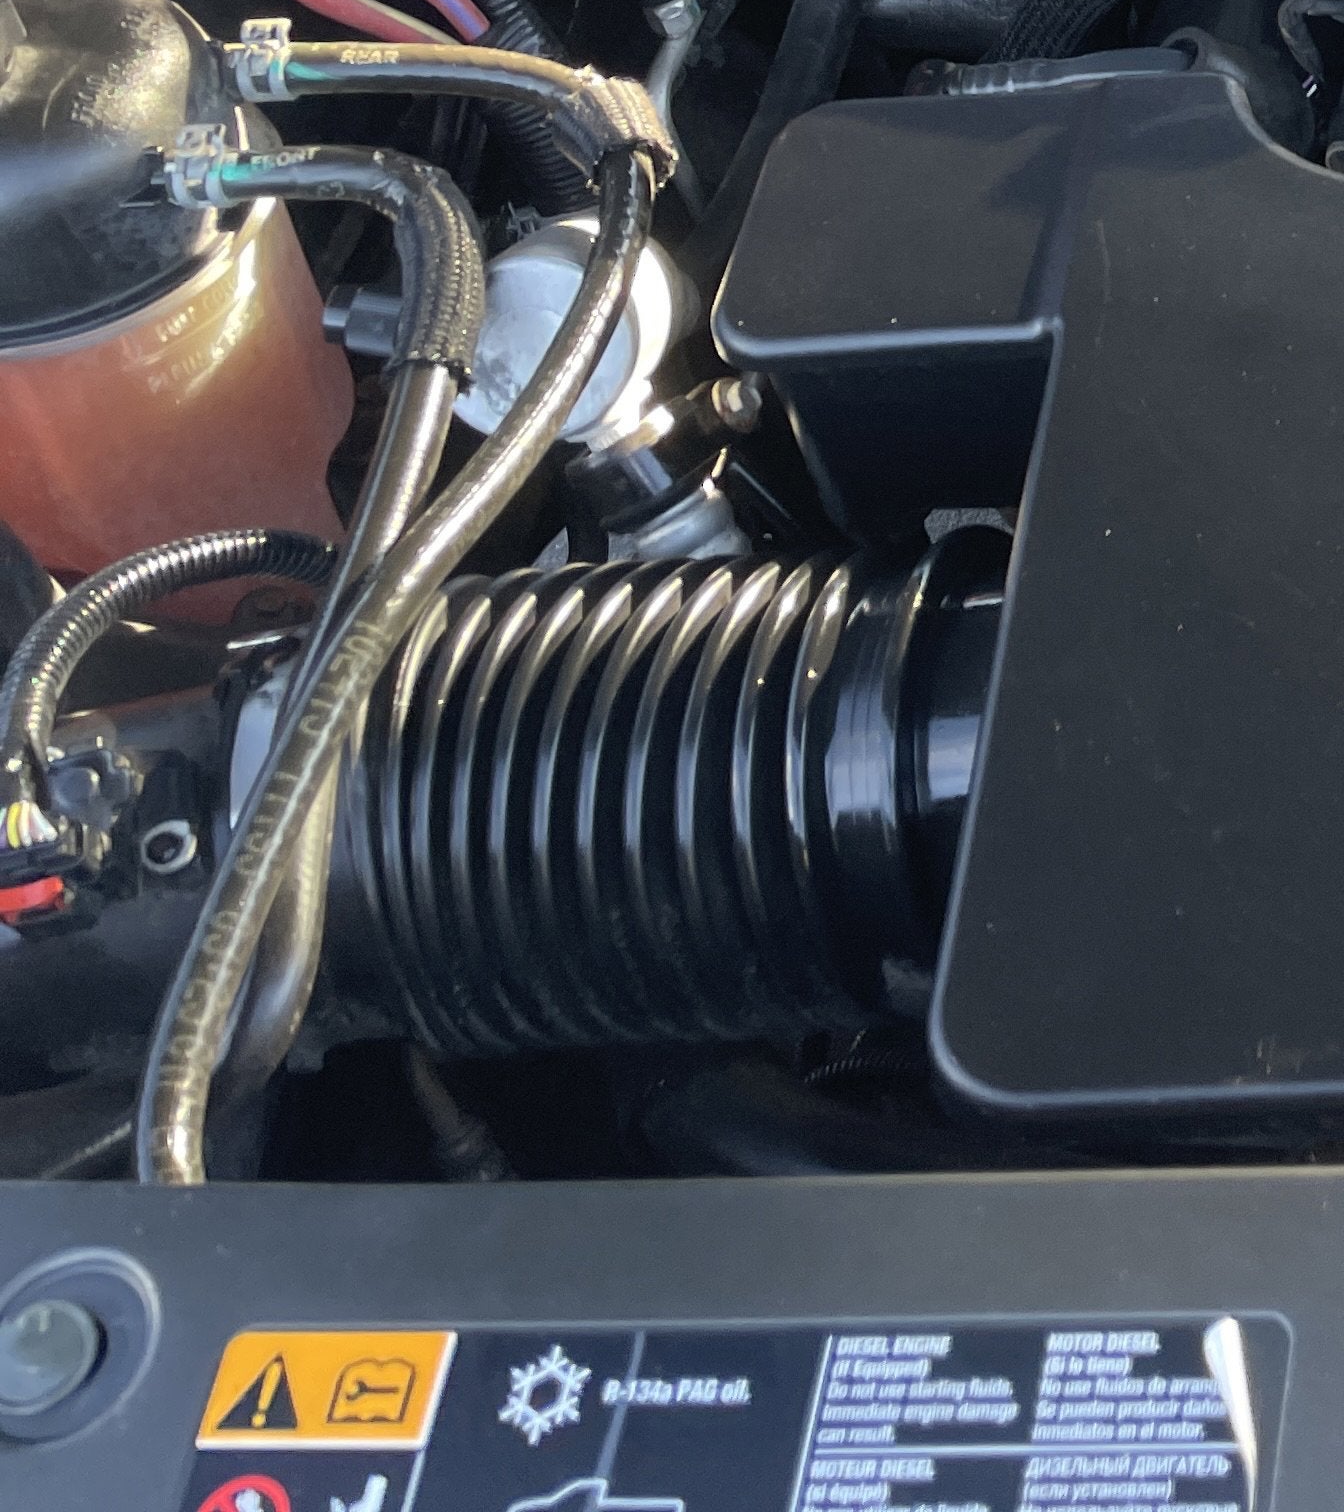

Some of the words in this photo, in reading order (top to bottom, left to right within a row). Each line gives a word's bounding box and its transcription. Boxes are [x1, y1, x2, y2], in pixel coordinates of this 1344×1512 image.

[837, 1335, 889, 1356] DIESEL
[893, 1334, 951, 1357] ENGINE
[1047, 1331, 1104, 1353] MOTOR
[677, 1378, 718, 1405] PAG
[828, 1381, 849, 1399] Do
[850, 1381, 876, 1399] not
[810, 1458, 878, 1480] MOTEUR
